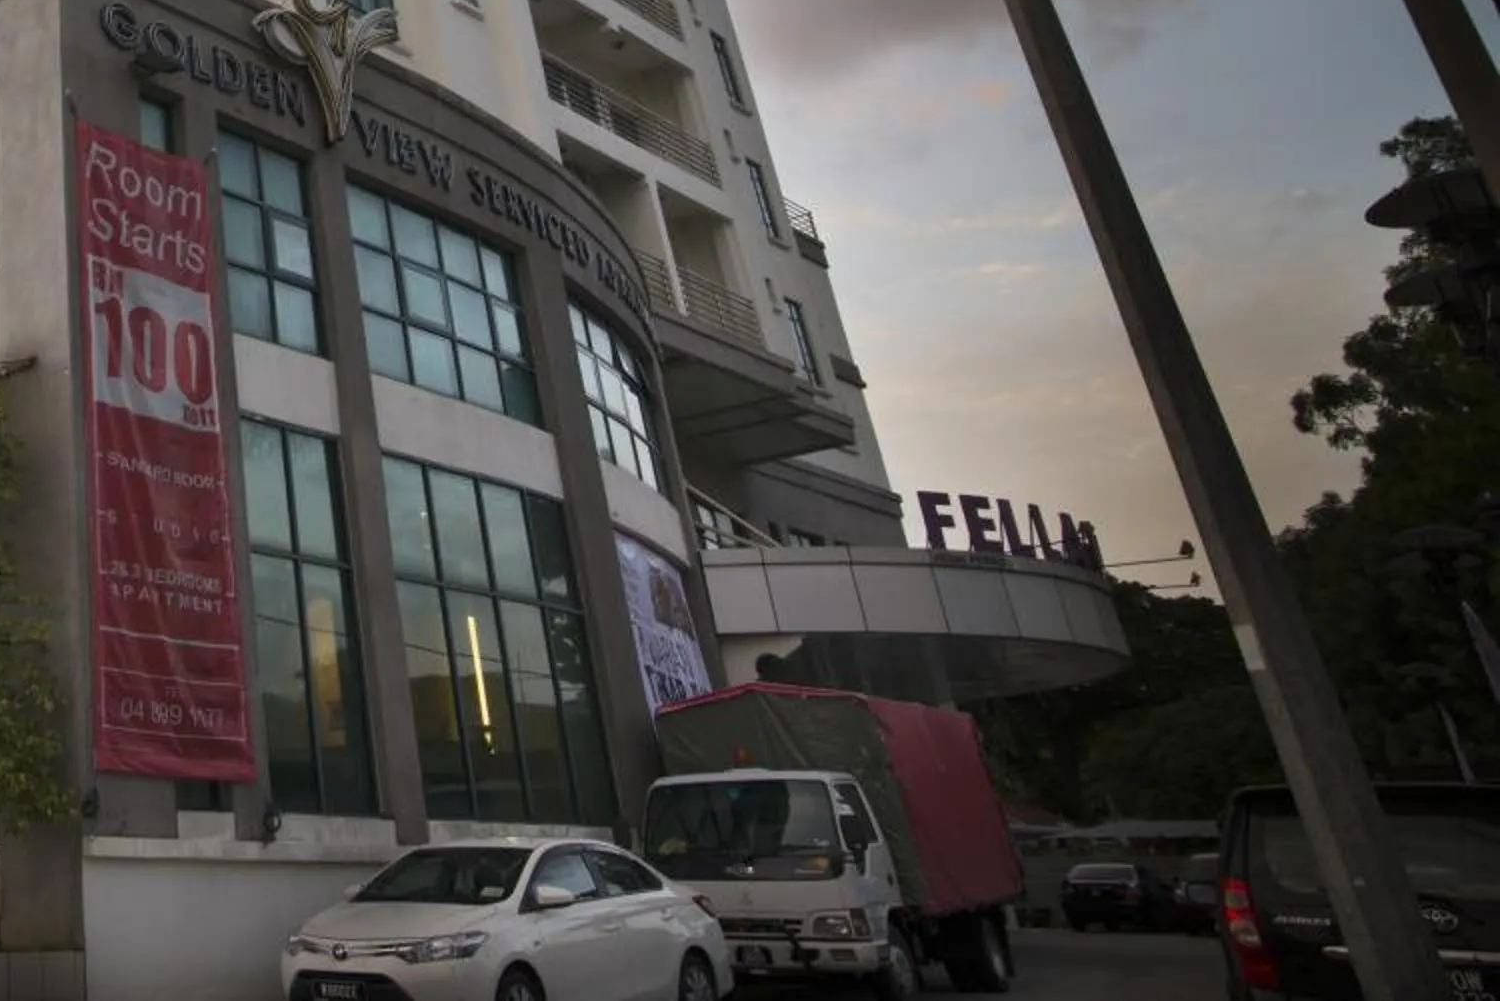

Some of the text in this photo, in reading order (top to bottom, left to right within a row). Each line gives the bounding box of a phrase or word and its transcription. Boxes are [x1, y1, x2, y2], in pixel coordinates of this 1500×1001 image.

[86, 141, 201, 220] Room
[100, 2, 591, 268] GOLDEN VIEW SERVICED
[87, 198, 206, 274] Starts
[95, 299, 212, 405] 100
